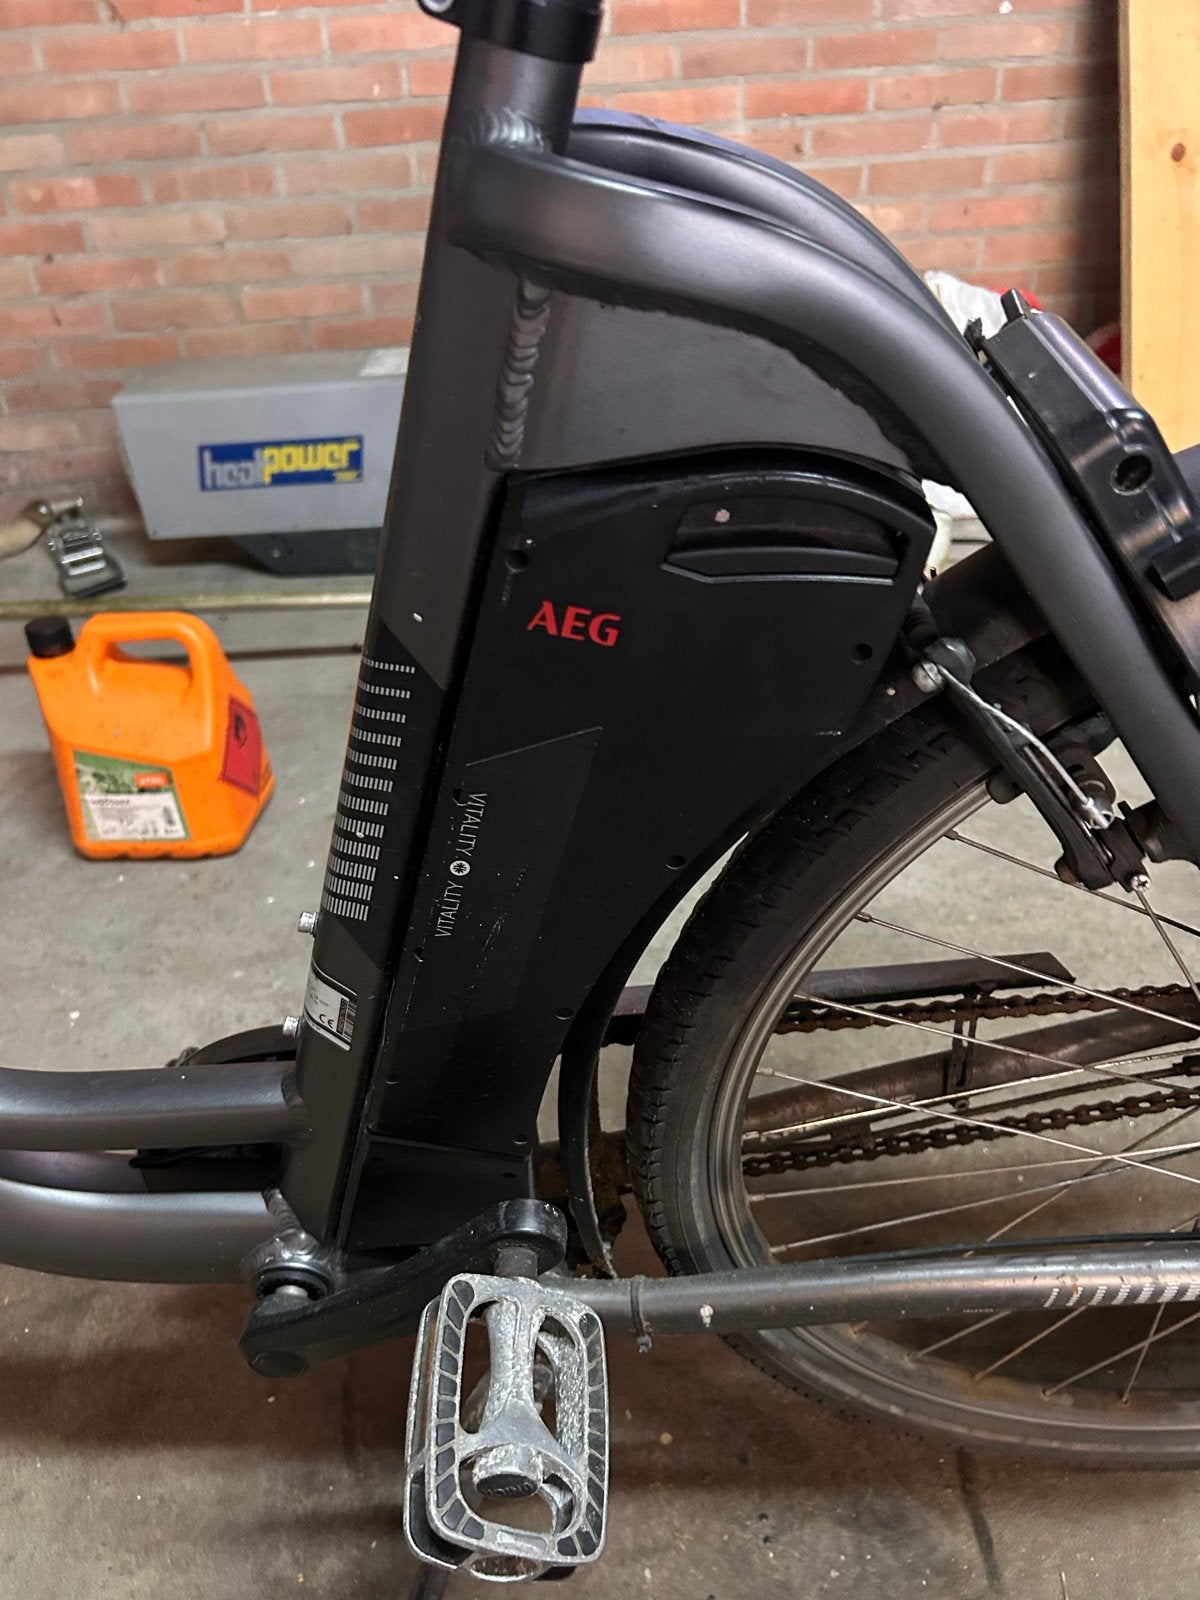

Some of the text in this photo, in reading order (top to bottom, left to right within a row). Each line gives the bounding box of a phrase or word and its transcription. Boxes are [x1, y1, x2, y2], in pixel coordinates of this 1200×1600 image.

[527, 600, 621, 647] AEG
[456, 793, 488, 857] VITALITY
[434, 880, 464, 937] VITALITY
